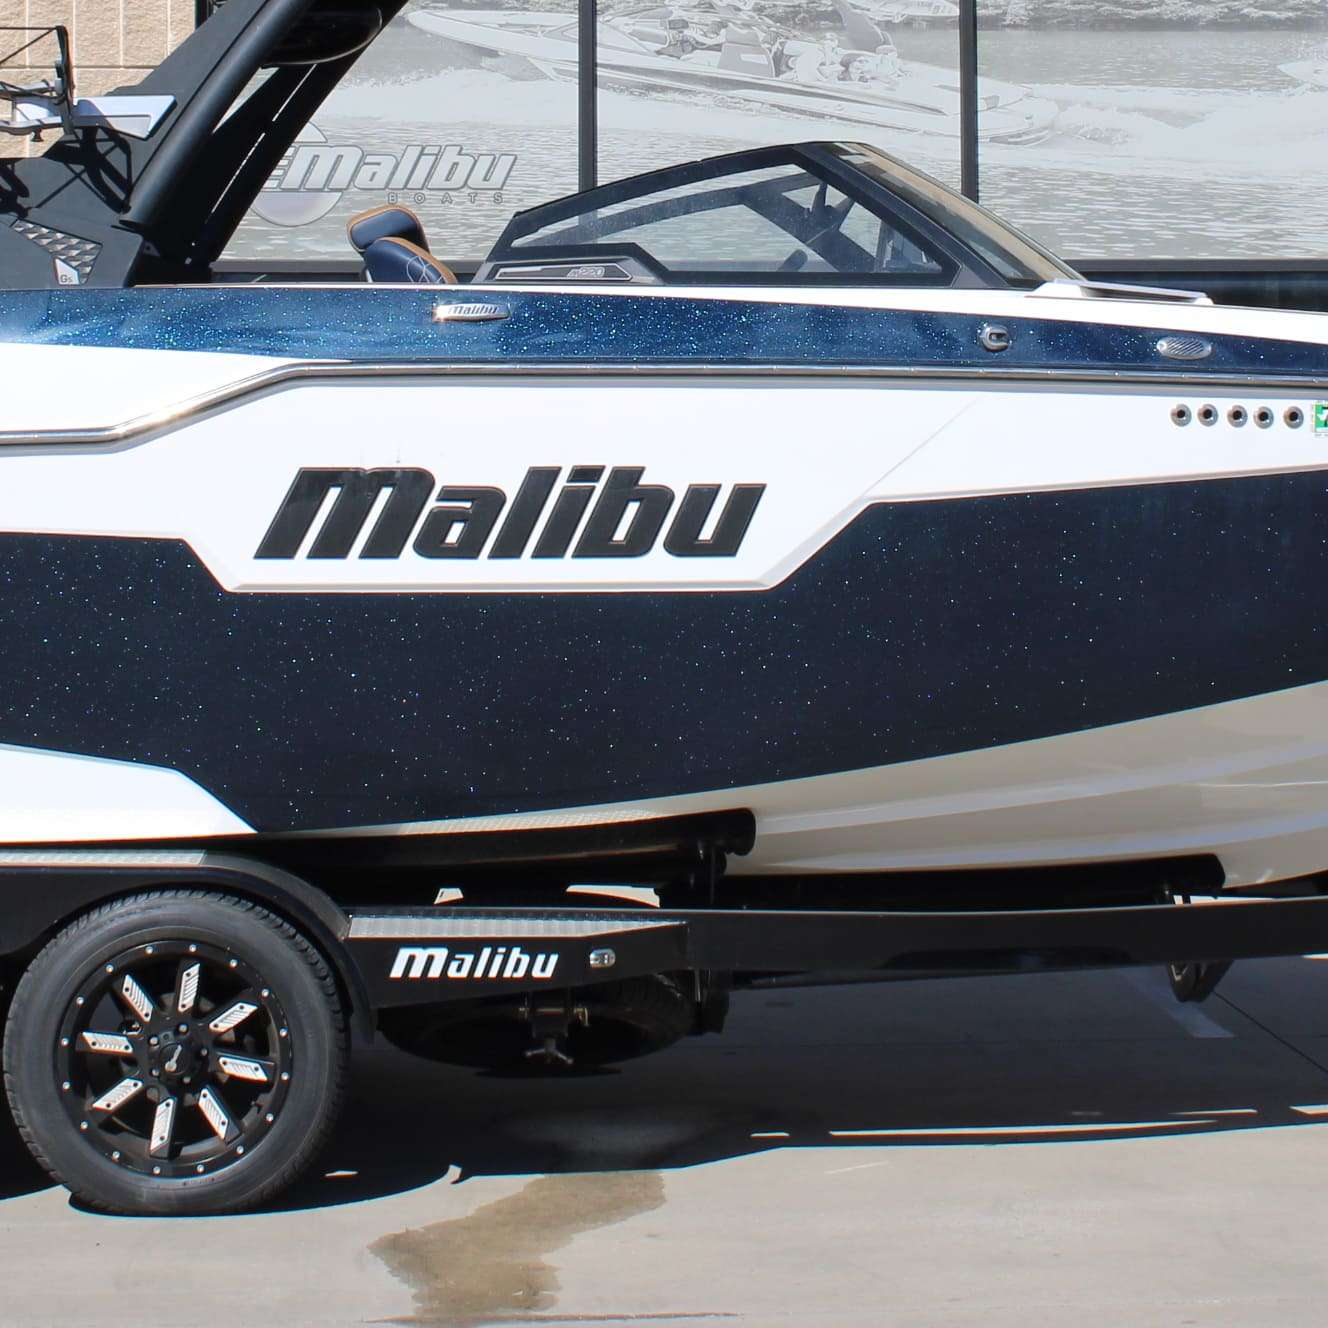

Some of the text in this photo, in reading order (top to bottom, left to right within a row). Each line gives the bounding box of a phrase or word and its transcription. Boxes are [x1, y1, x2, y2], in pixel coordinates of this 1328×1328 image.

[278, 144, 518, 191] Malibu
[387, 191, 504, 205] BOATS
[252, 465, 767, 560] Malibu
[389, 946, 560, 979] Malibu
